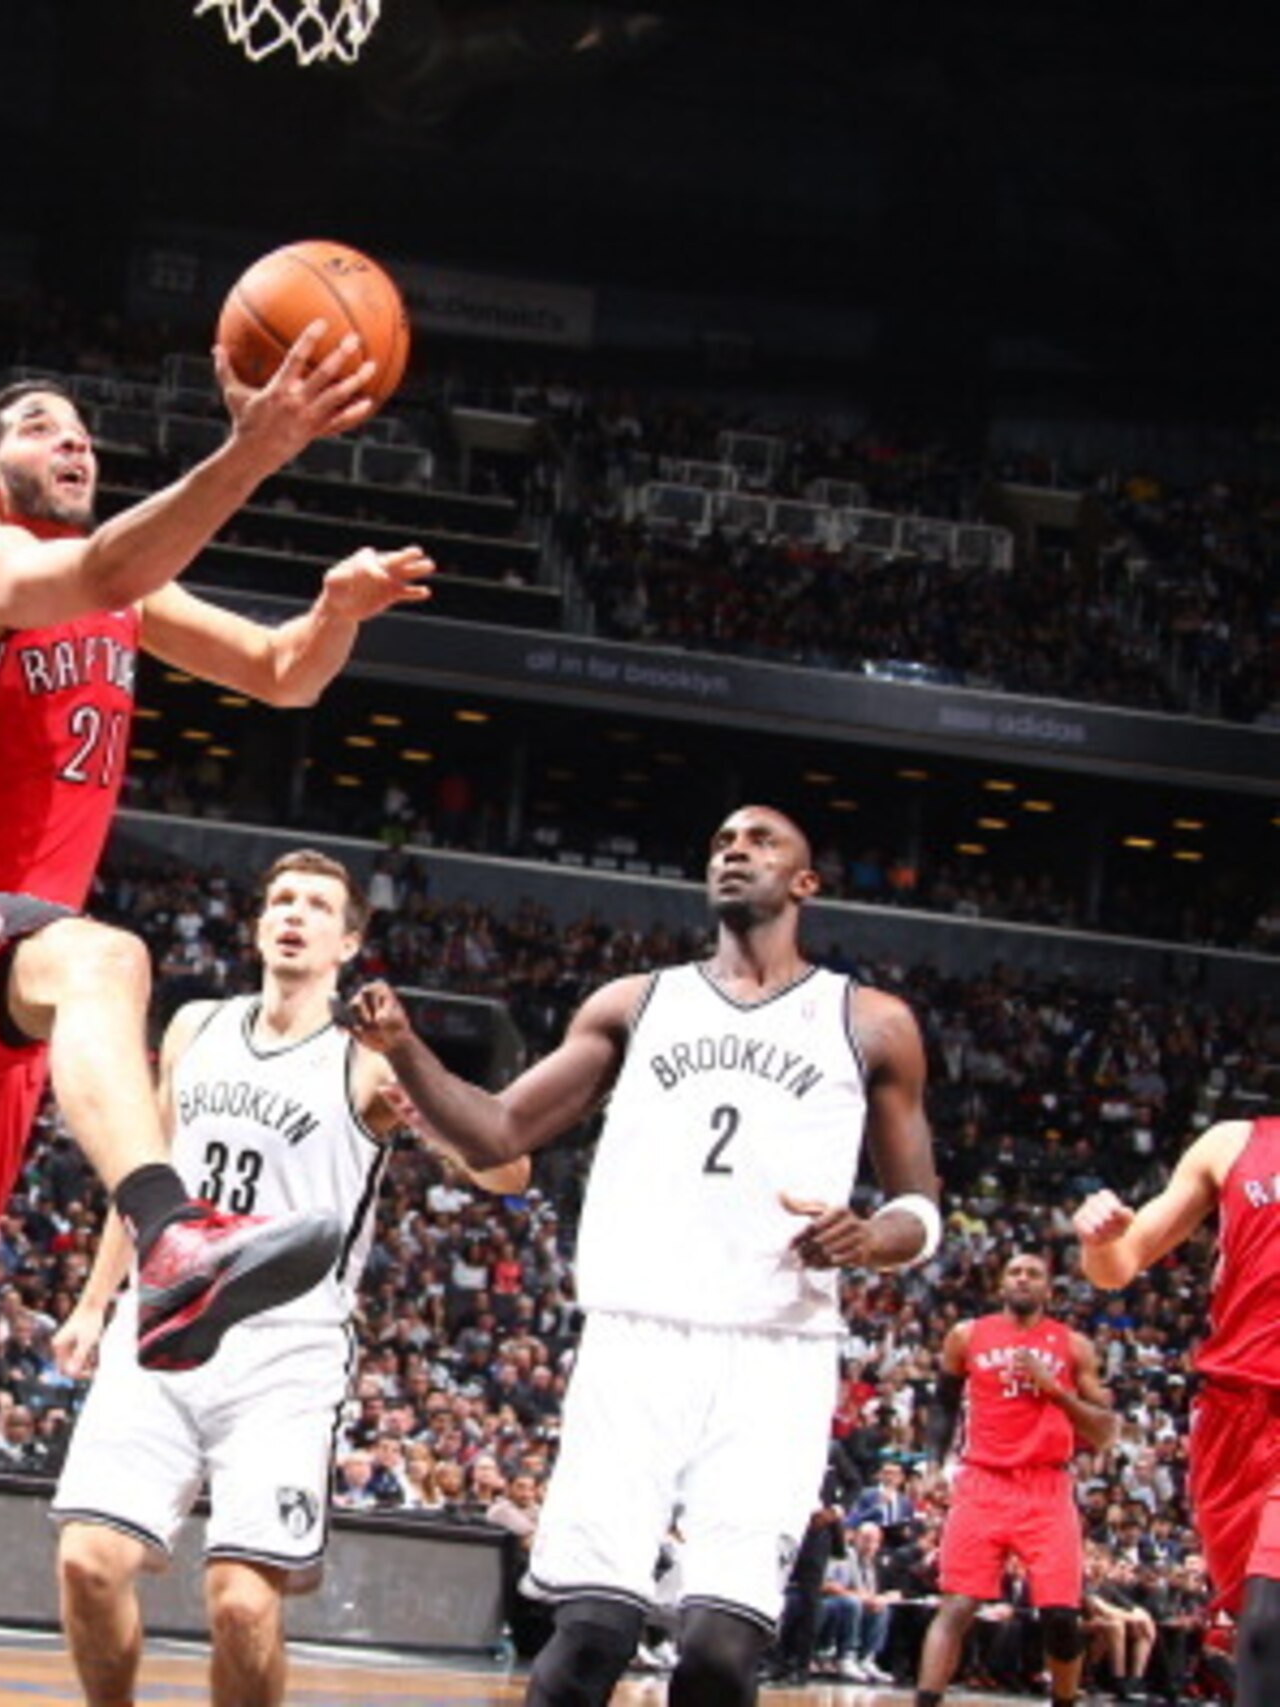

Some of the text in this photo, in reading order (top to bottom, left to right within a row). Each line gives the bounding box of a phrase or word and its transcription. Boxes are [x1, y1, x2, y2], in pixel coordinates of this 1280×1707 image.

[525, 648, 731, 697] all in for brooklyn
[996, 714, 1087, 742] adidas
[649, 1033, 823, 1101] BROOKLYN
[179, 1080, 320, 1147] BROOKLYN
[702, 1102, 742, 1175] 2
[197, 1140, 264, 1216] 33
